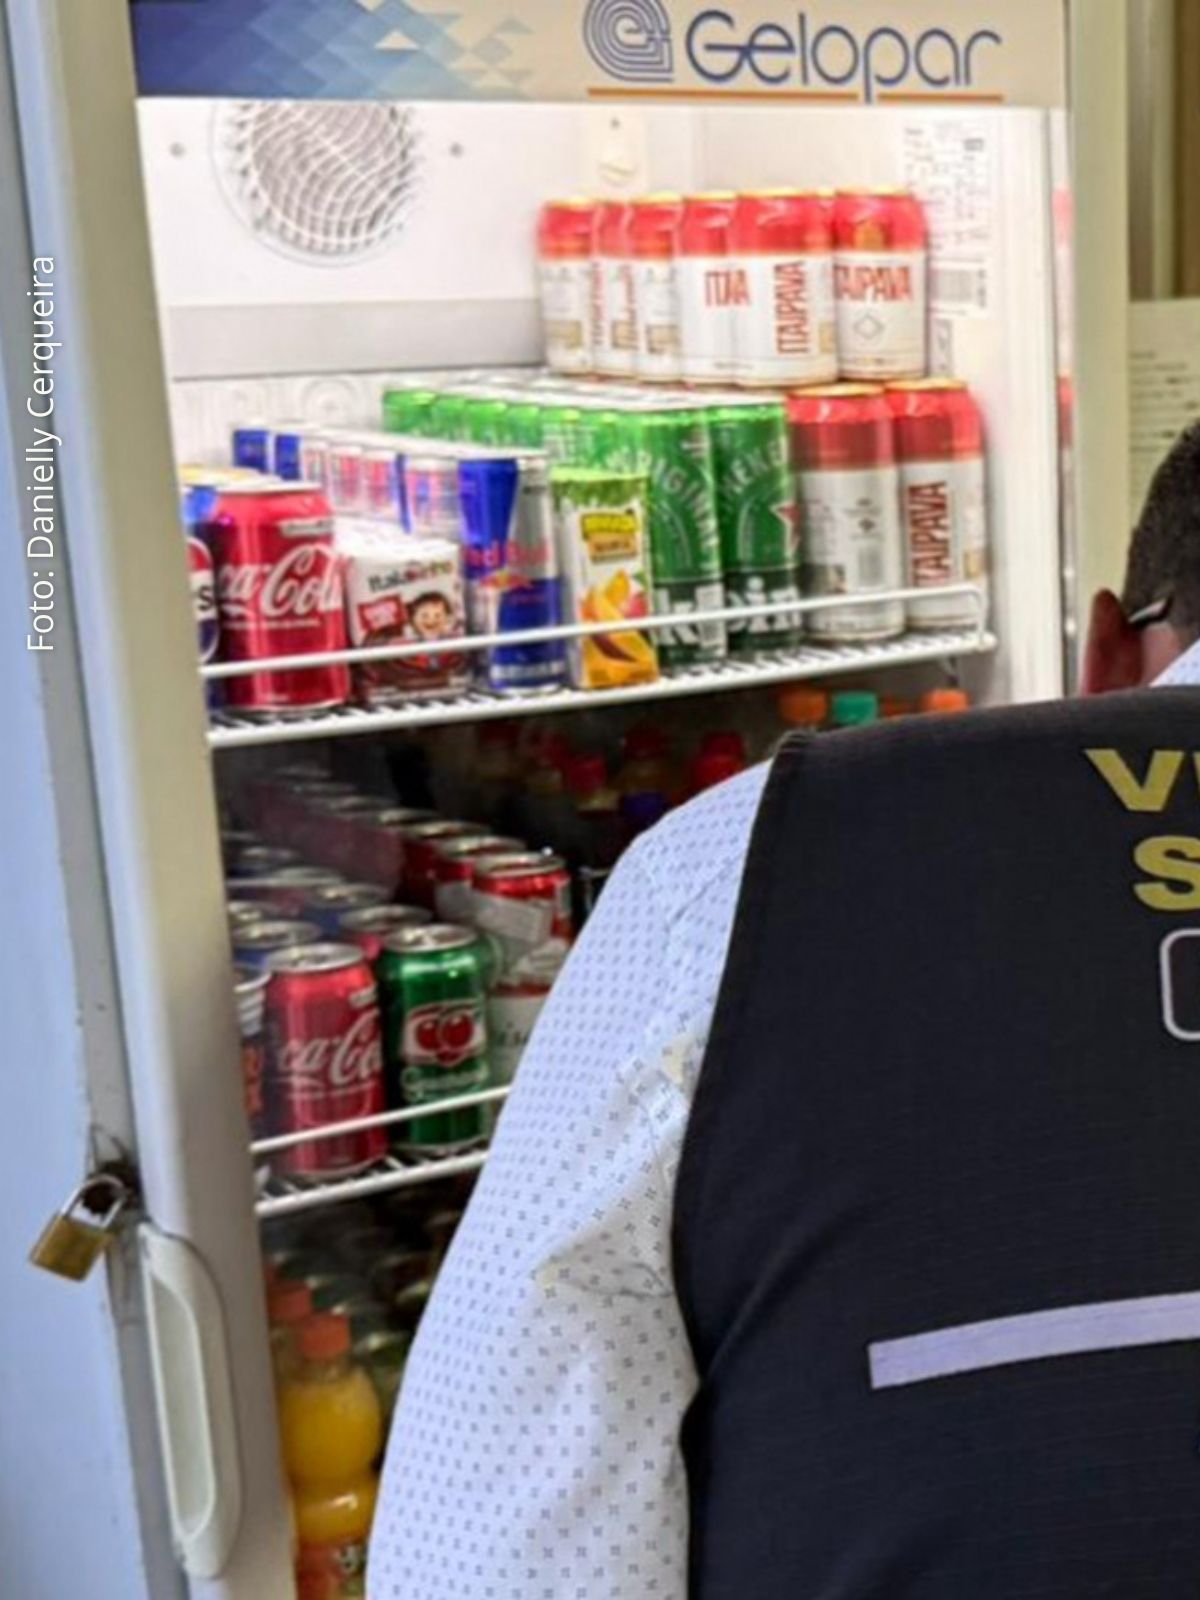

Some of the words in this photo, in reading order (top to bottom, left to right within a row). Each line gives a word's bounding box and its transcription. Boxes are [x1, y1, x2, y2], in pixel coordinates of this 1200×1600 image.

[685, 10, 1002, 104] Gelopar
[832, 264, 913, 303] TAIPAVA
[908, 481, 950, 590] TAIPAVA
